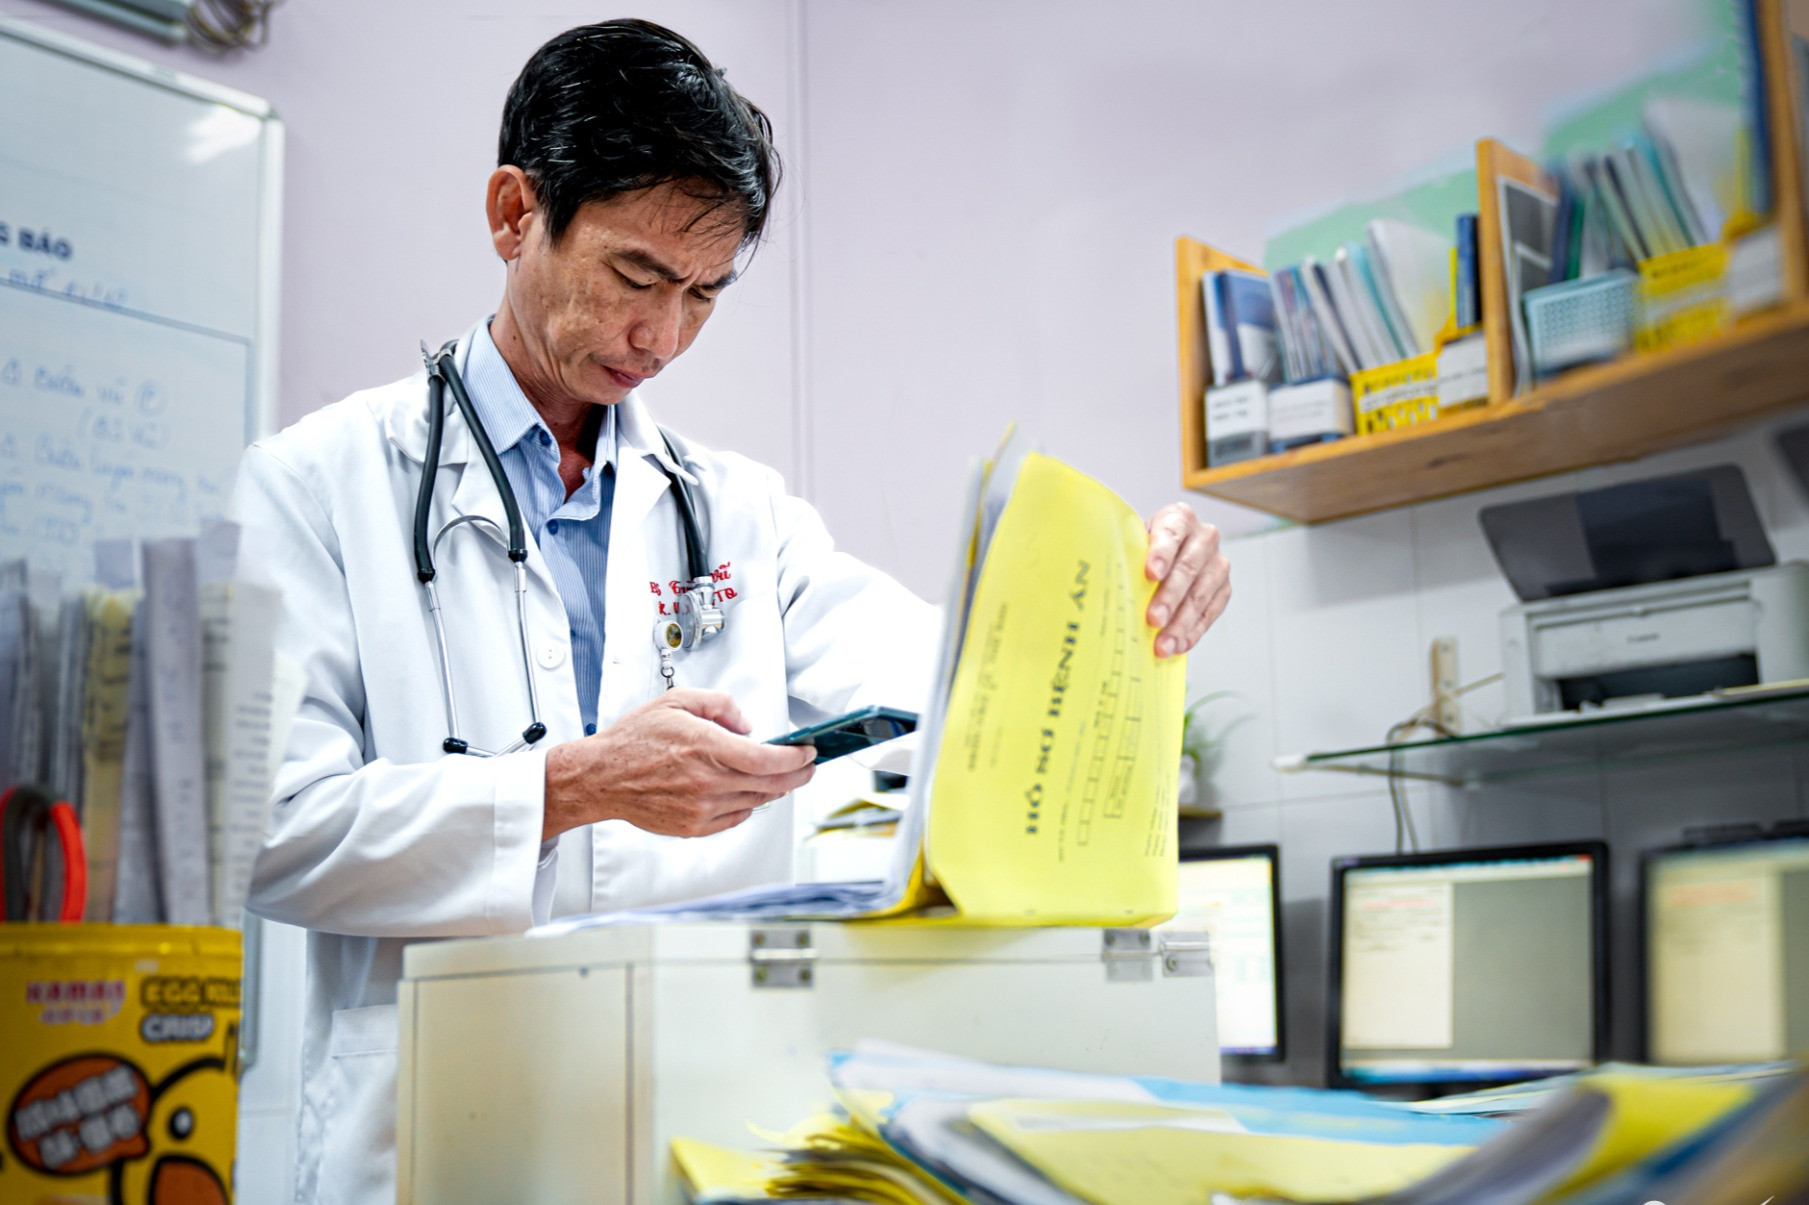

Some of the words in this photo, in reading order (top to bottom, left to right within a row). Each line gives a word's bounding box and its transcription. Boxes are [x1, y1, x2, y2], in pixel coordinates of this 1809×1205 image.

[1036, 728, 1054, 774] SƠ
[1048, 621, 1080, 717] BỆNH
[1069, 560, 1090, 611] ÁN
